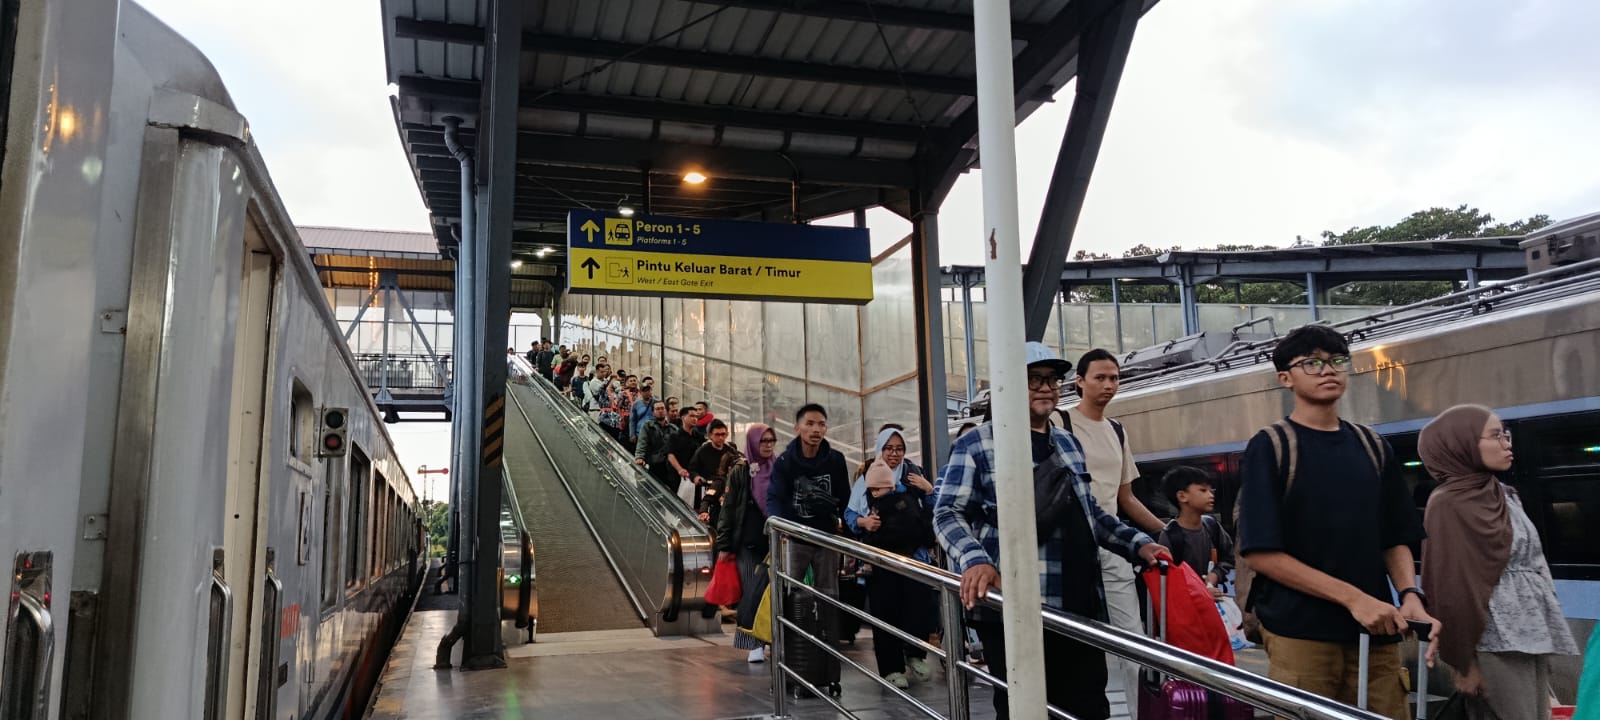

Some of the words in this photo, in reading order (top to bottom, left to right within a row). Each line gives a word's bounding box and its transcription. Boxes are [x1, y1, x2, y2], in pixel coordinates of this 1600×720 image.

[636, 221, 674, 233] Peron
[637, 236, 672, 245] Platforms
[637, 260, 670, 272] Pintu
[675, 261, 716, 274] Keluar
[719, 264, 752, 276] Barat
[755, 266, 761, 276] /
[765, 266, 801, 278] Timur
[638, 277, 655, 285] West
[663, 278, 679, 286] East
[680, 279, 698, 287] Gate
